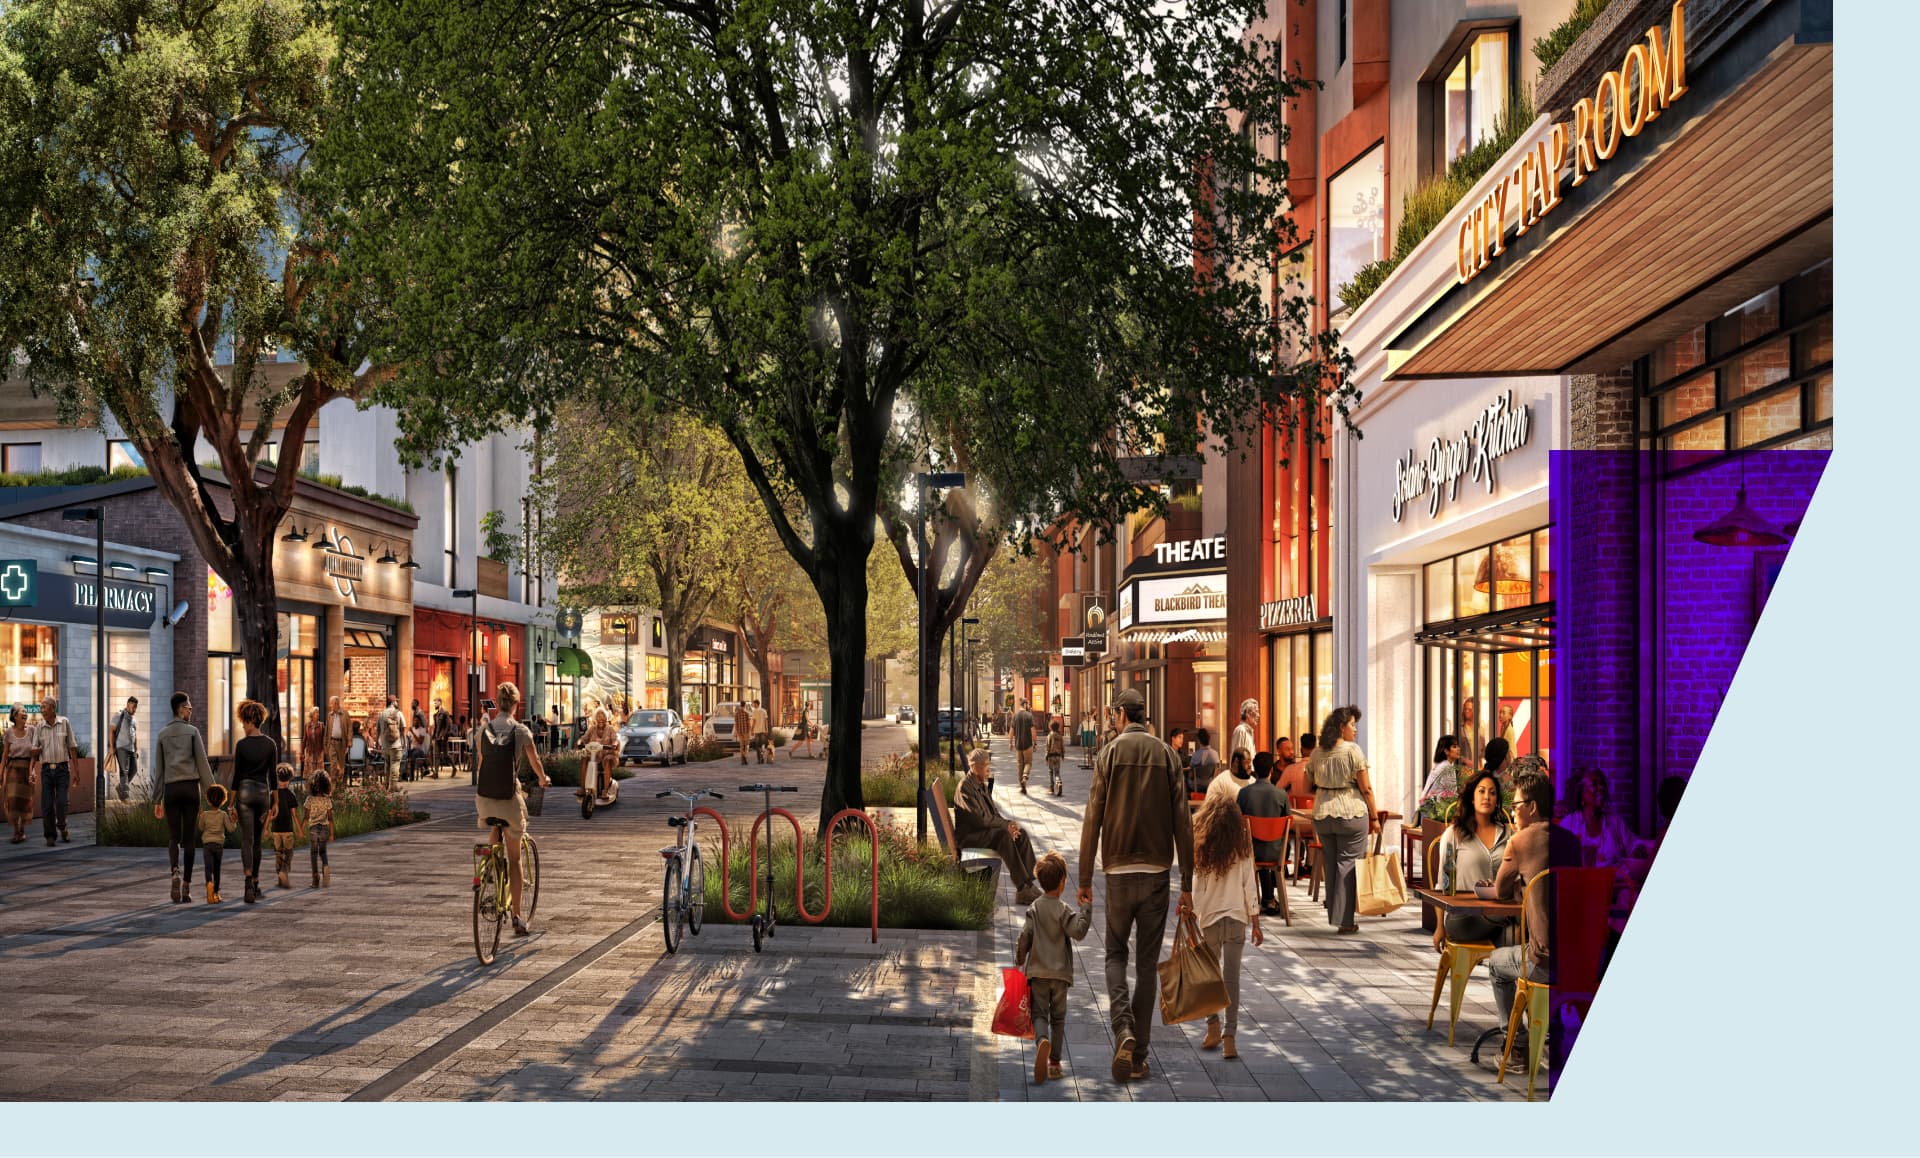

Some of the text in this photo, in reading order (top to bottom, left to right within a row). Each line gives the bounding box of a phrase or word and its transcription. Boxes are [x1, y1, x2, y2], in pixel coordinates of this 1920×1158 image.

[1456, 0, 1689, 285] CITY TAP ROOM
[1392, 389, 1529, 523] Solano Burger Kitchen
[1154, 536, 1228, 564] THEATE
[74, 582, 154, 613] PHRMACY
[1154, 594, 1201, 613] BLACKBIRD
[1203, 593, 1227, 611] THEA
[1259, 593, 1318, 630] PIZZERIA
